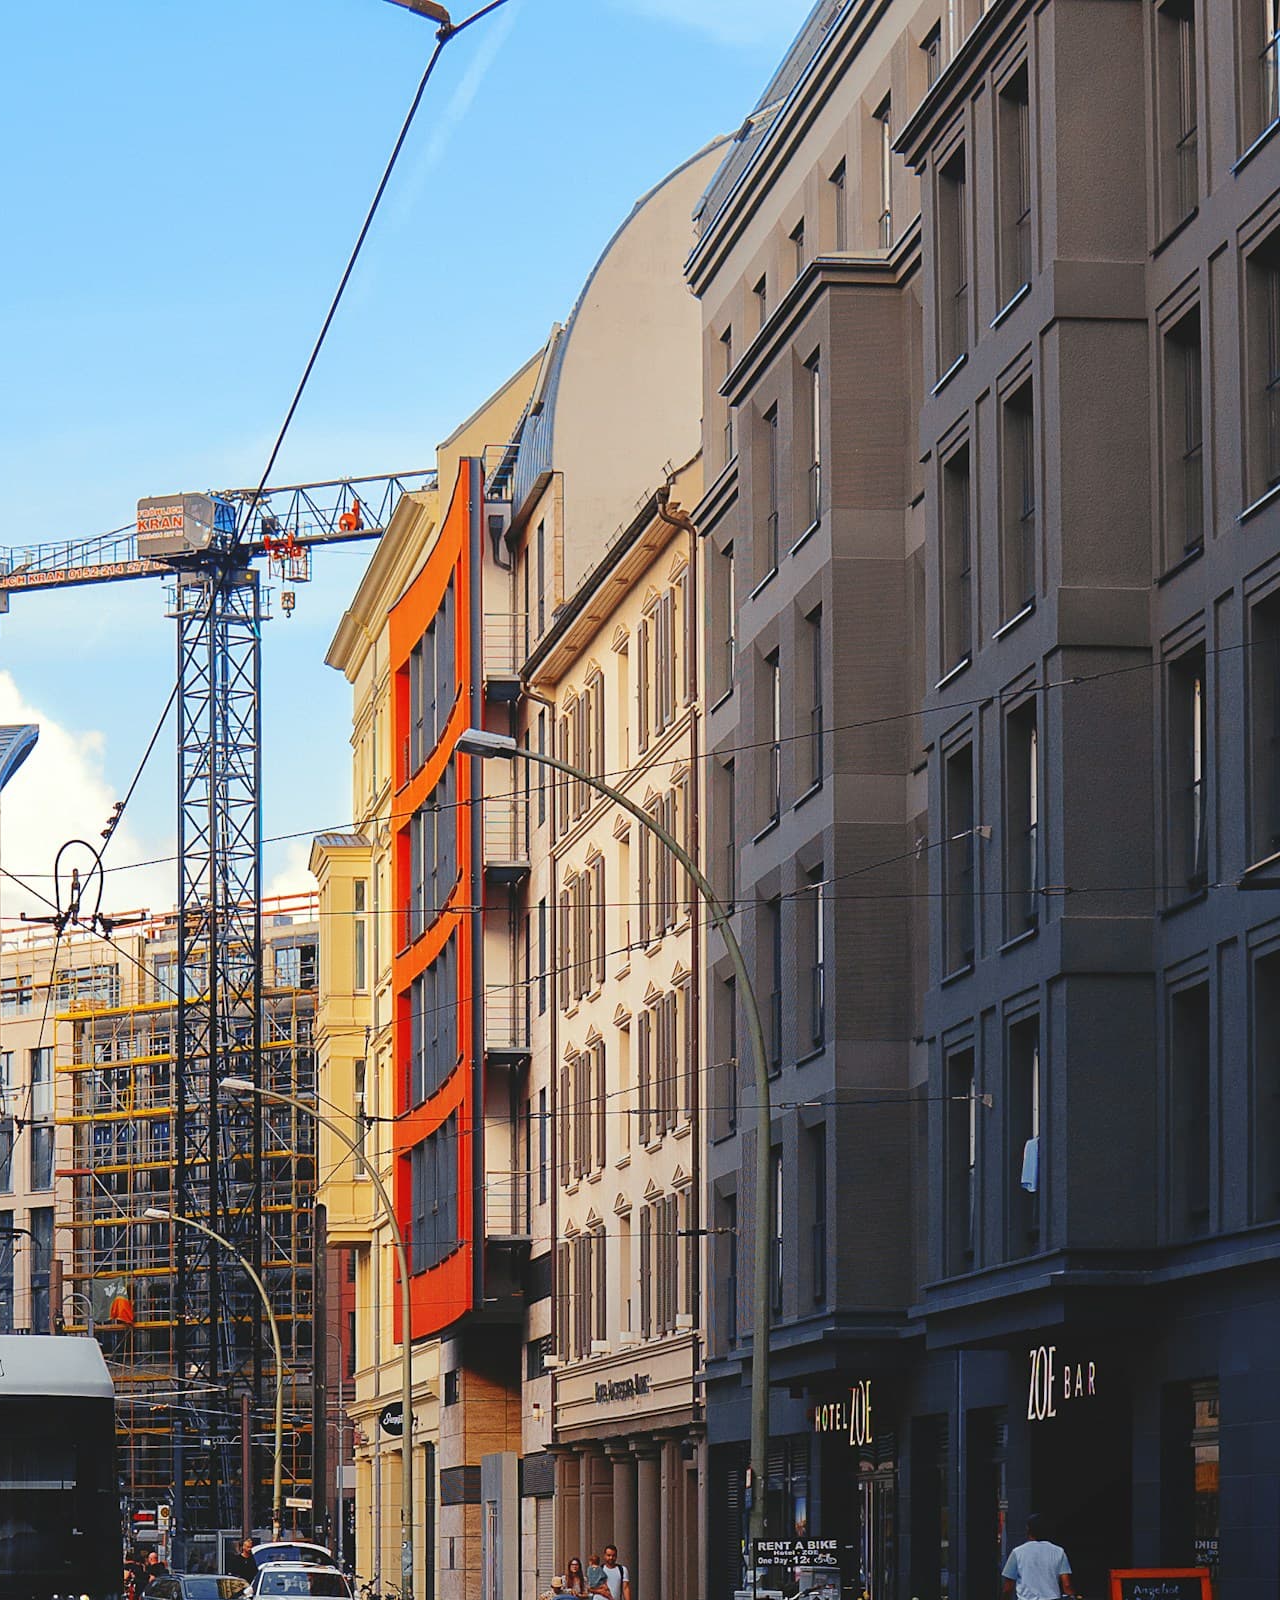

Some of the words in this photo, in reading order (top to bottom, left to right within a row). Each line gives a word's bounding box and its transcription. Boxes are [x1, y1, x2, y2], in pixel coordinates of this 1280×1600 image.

[137, 506, 184, 518] FRÖHLICH
[137, 516, 184, 533] KRAN
[28, 570, 66, 584] KRAN
[1027, 1346, 1057, 1420] ZOE
[1064, 1361, 1096, 1399] BAR
[815, 1403, 847, 1432] HOTEL
[848, 1380, 872, 1446] ZOE
[758, 1541, 791, 1551] RENT
[795, 1541, 804, 1550] A
[808, 1540, 837, 1549] BIKE
[1133, 1583, 1179, 1600] Angebot
